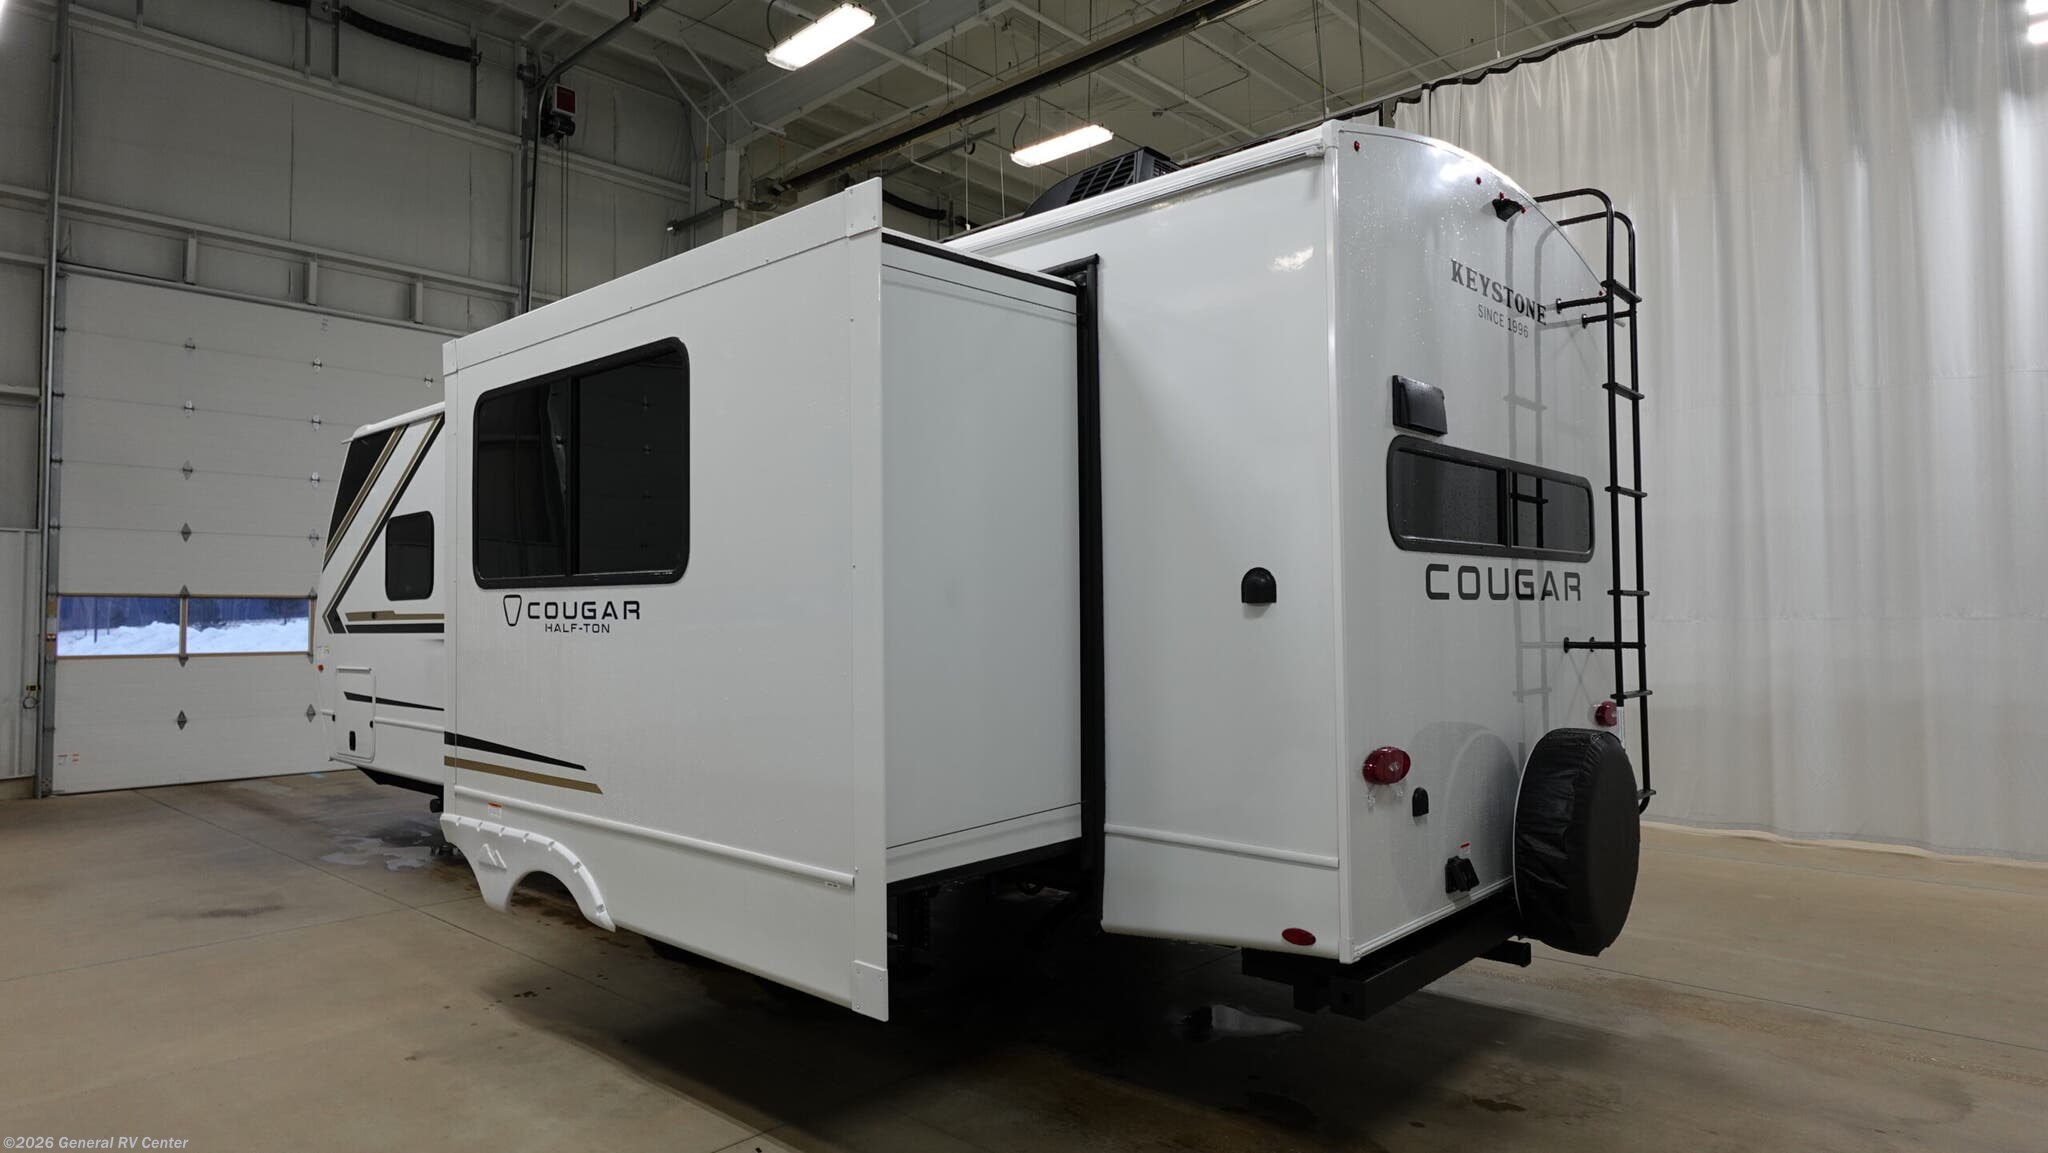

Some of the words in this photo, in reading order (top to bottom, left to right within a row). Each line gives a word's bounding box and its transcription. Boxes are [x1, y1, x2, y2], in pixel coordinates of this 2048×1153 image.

[1451, 259, 1547, 326] KEYSTONE
[1478, 304, 1505, 328] SINCE
[1507, 317, 1529, 339] 1996
[1425, 563, 1582, 601] COUGAR
[527, 600, 641, 620] COUGAR
[545, 623, 611, 634] HALF-TON
